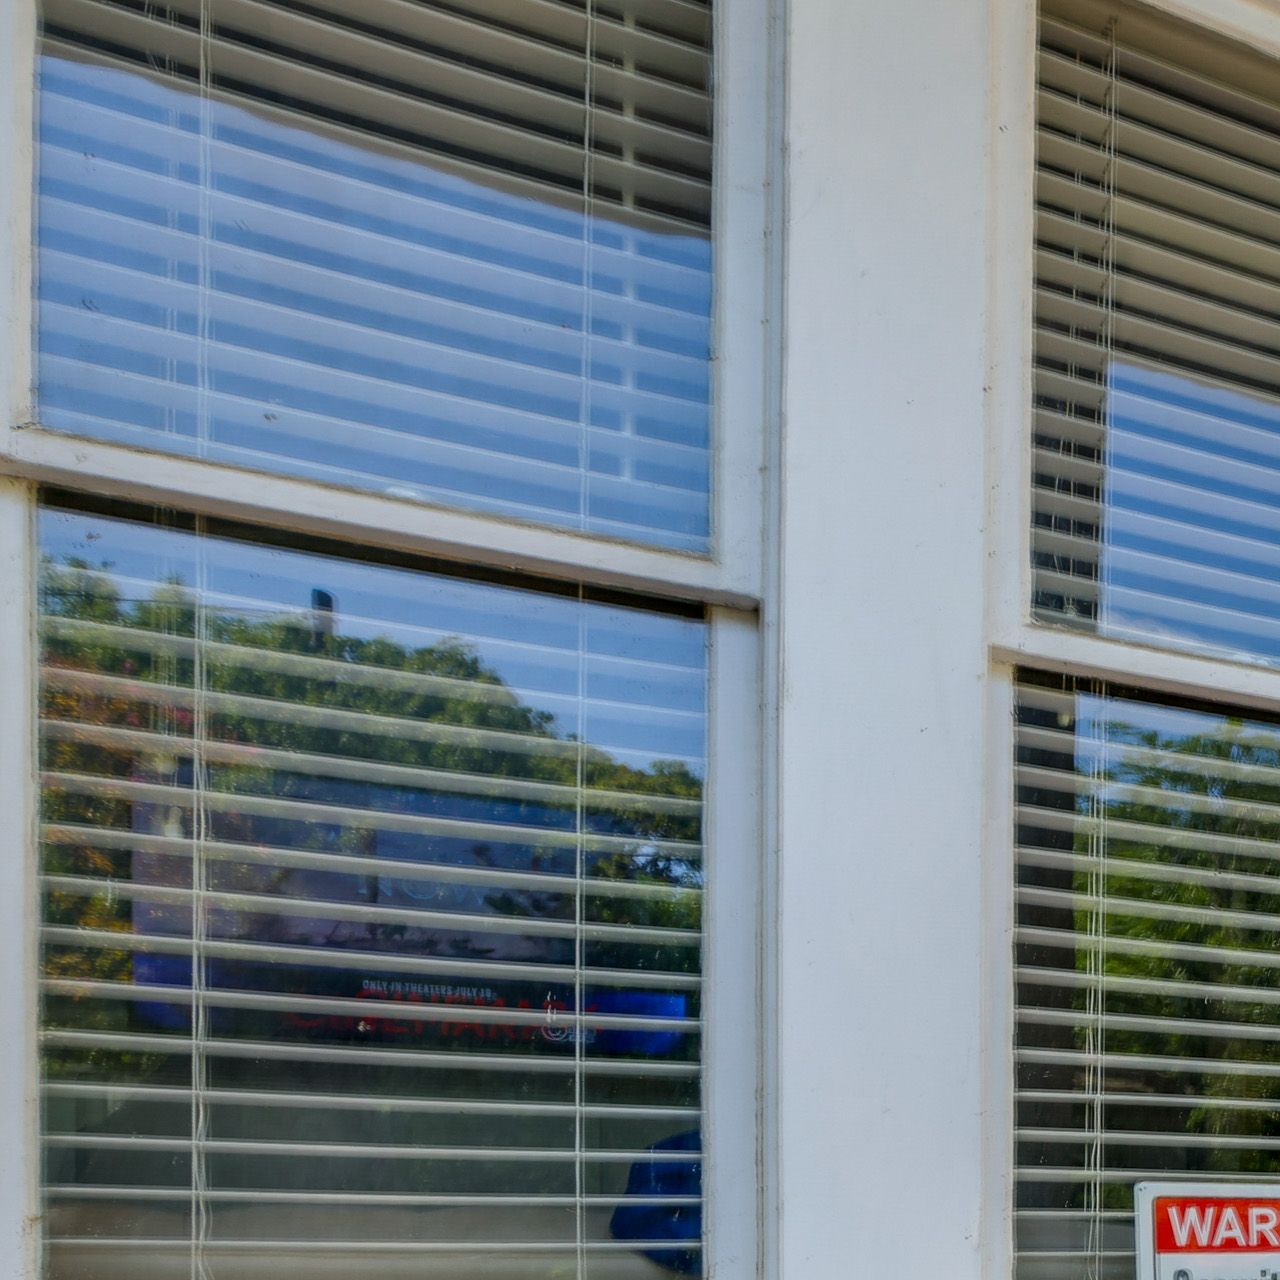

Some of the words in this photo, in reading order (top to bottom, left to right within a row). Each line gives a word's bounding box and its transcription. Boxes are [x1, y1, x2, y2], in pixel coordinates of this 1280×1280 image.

[361, 979, 388, 994] ONLY
[404, 982, 453, 996] THEATERS
[455, 986, 478, 997] JULY
